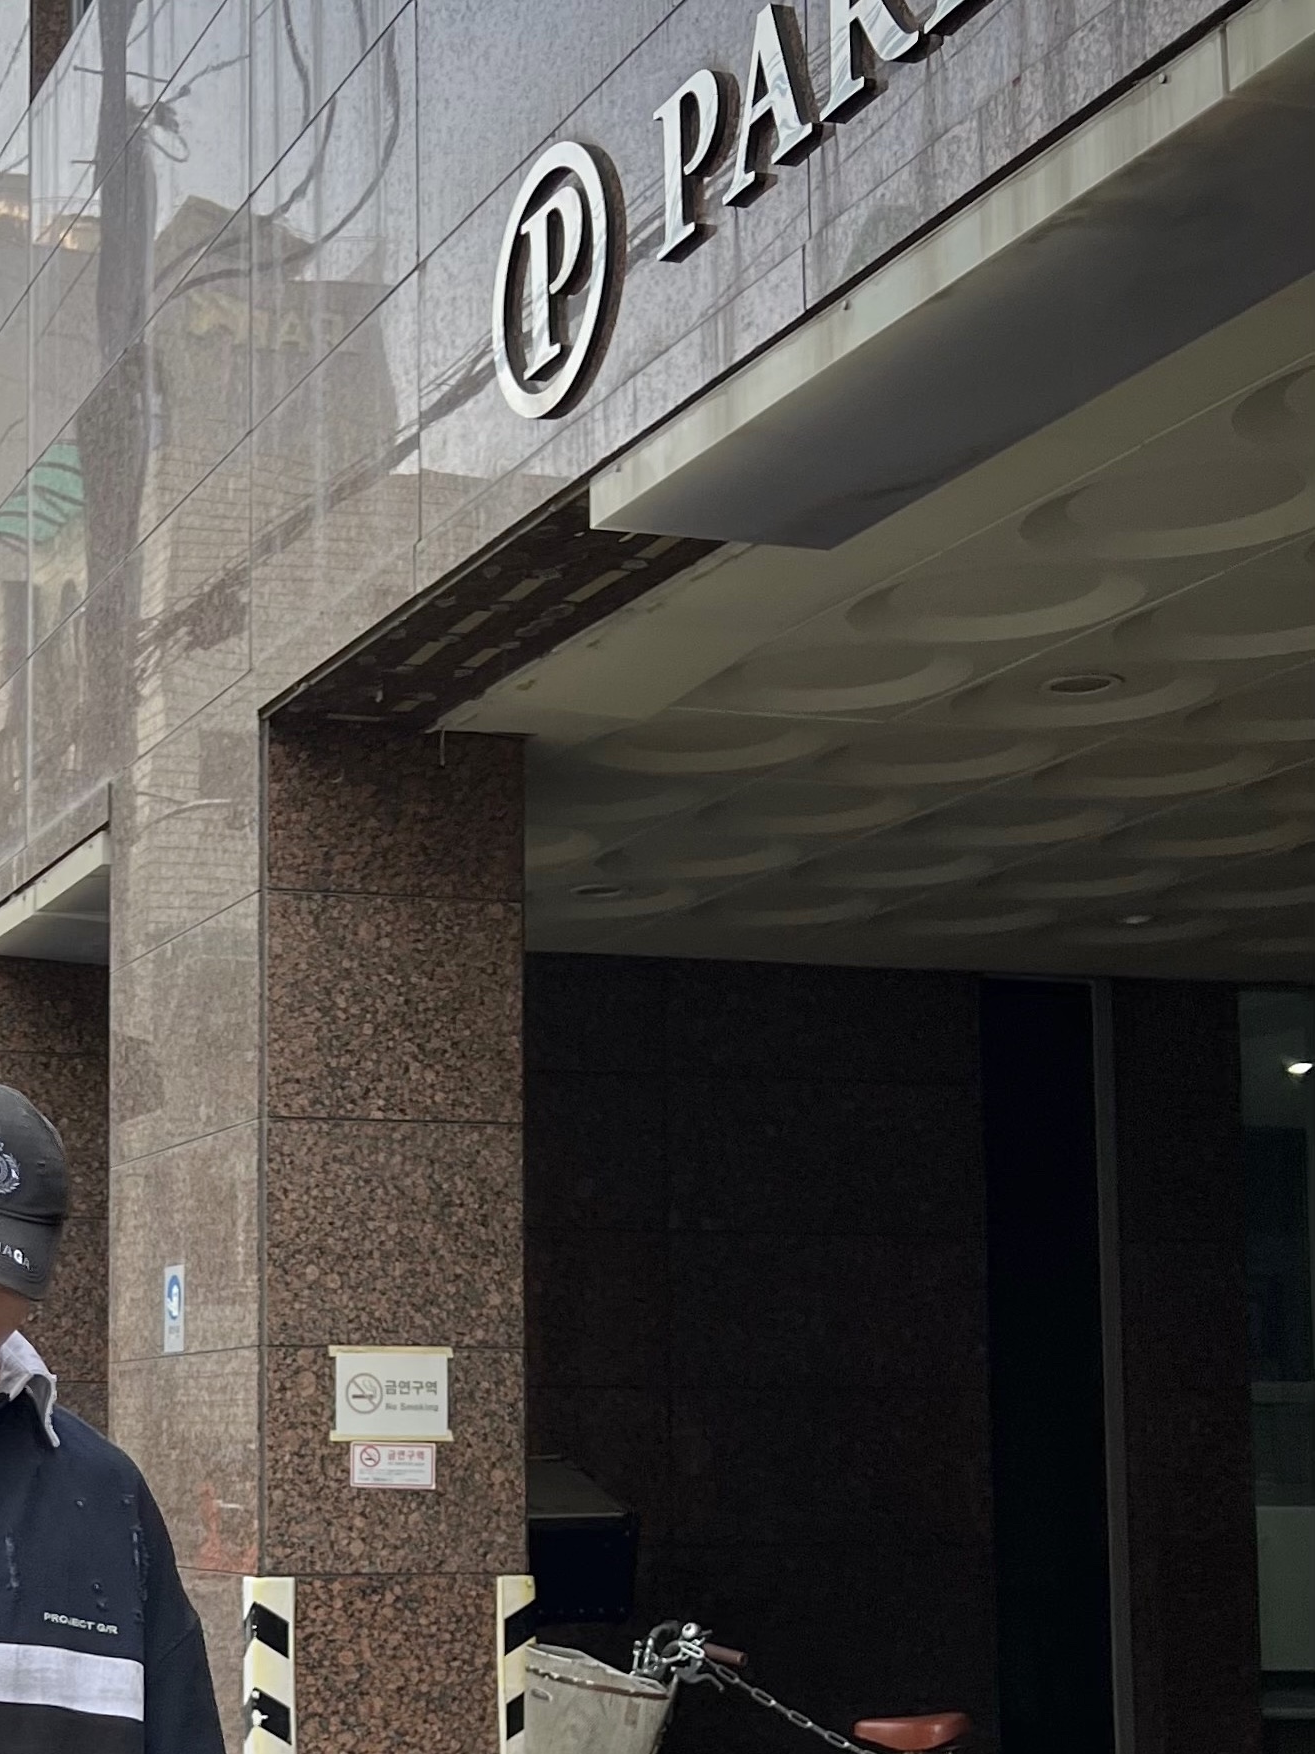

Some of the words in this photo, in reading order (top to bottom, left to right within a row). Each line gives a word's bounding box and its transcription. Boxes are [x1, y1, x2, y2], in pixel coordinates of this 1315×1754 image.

[653, 0, 987, 262] PAR
[385, 1380, 437, 1395] 금연구역
[43, 1611, 96, 1630] PROJECT
